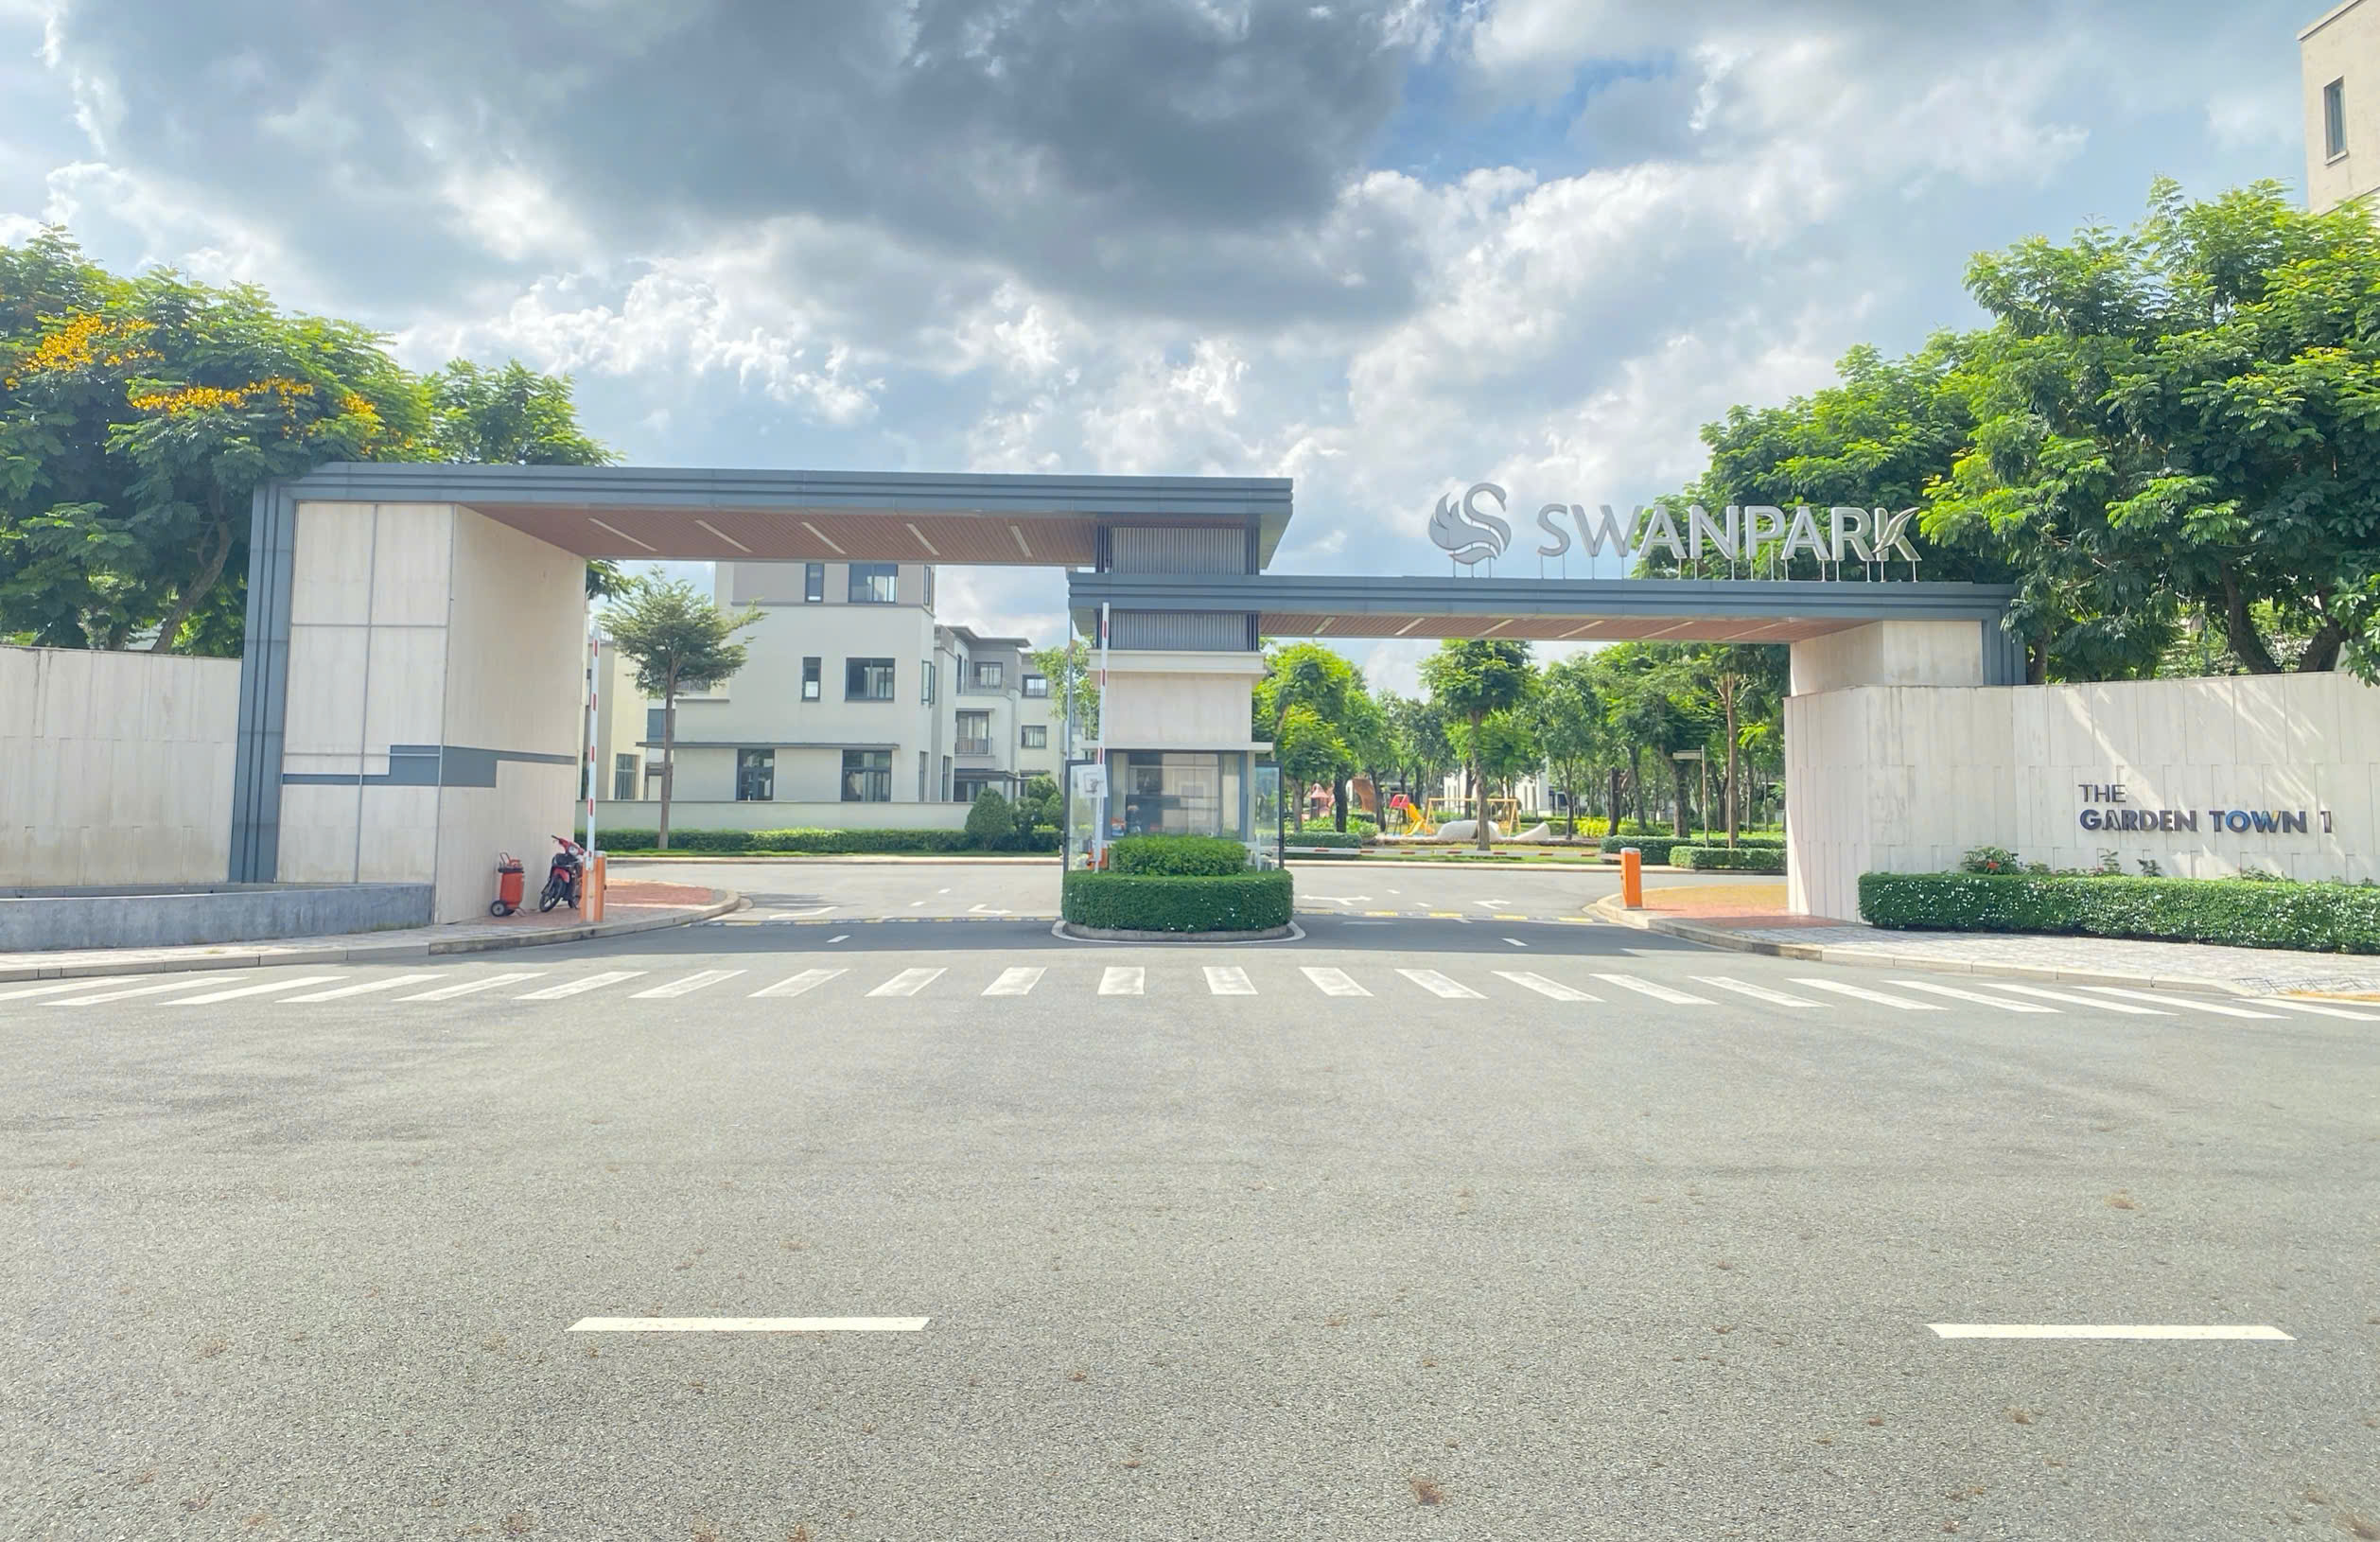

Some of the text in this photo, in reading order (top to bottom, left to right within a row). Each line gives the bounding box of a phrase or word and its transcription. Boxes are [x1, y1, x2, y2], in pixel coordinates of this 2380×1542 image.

[1537, 504, 1922, 562] SWANPARK
[2078, 784, 2126, 803] THE
[2080, 809, 2333, 833] GARDEN TOWN 1
